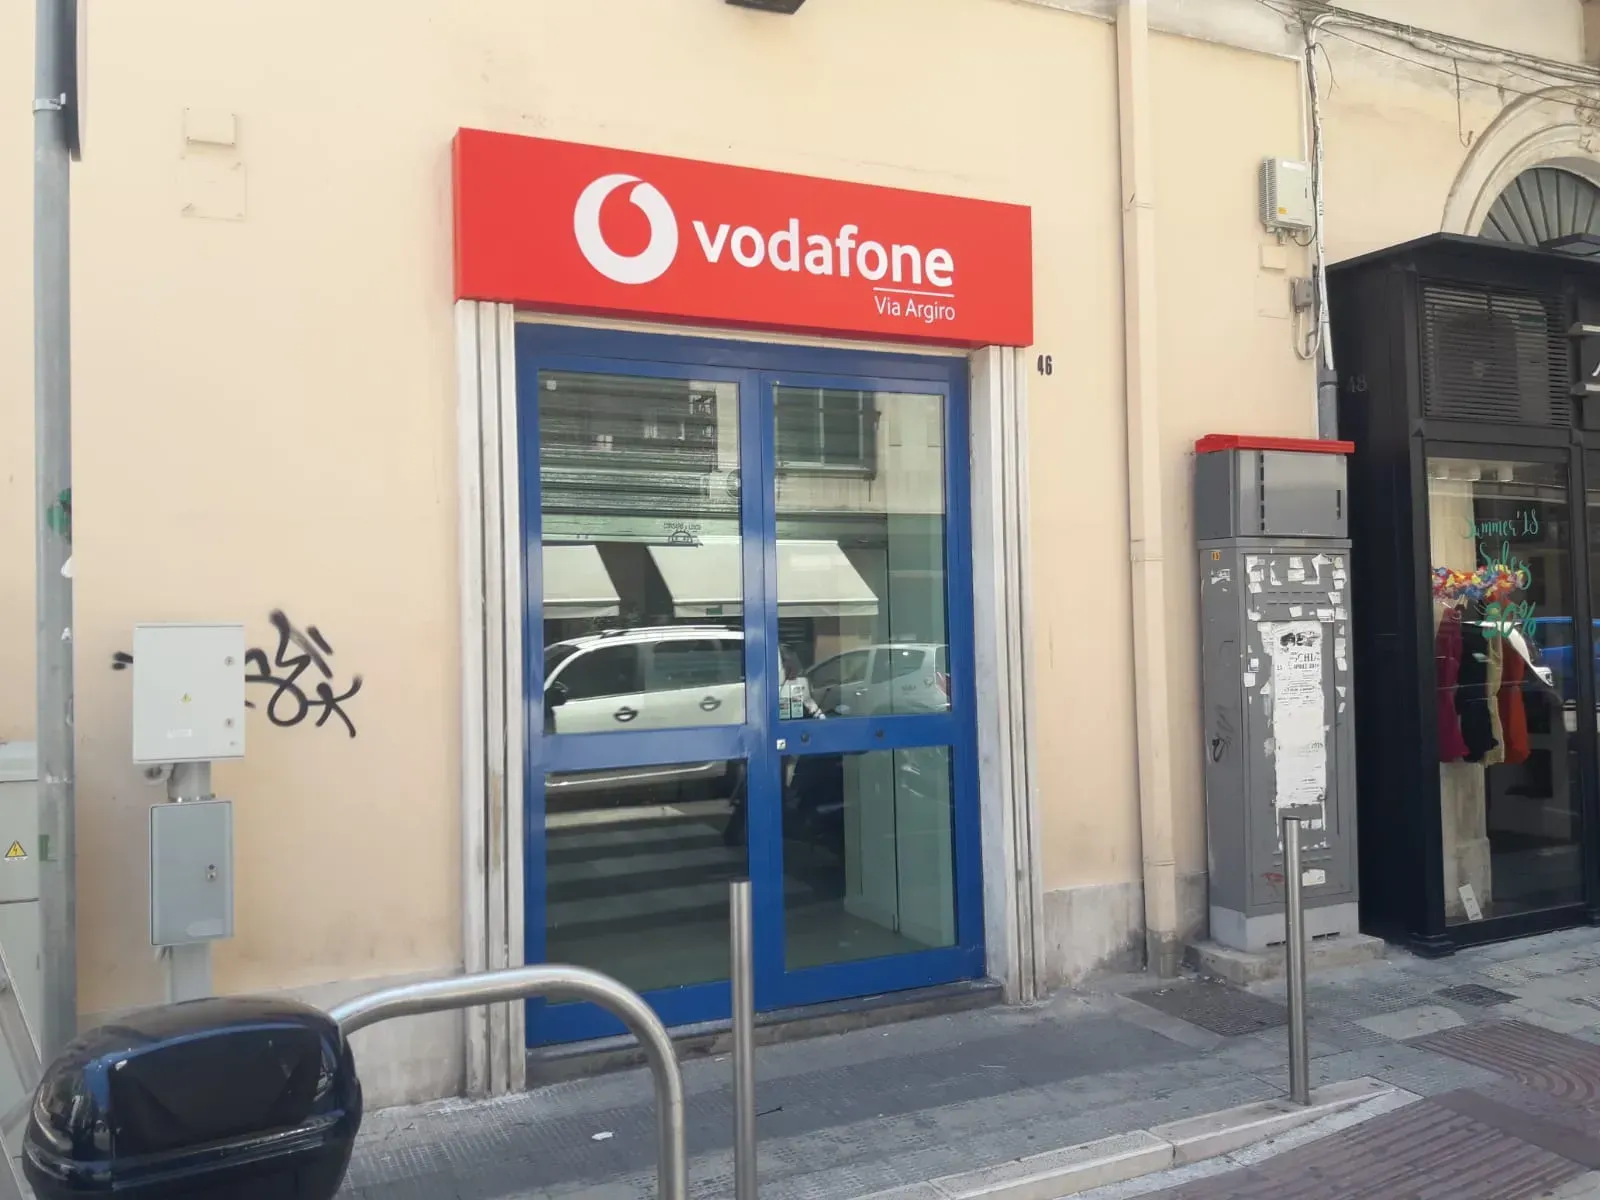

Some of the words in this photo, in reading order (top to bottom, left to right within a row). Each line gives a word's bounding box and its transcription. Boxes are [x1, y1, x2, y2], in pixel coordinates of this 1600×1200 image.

[692, 218, 954, 287] vodafone
[874, 295, 901, 316] Via
[905, 298, 956, 324] Argiro
[1037, 354, 1053, 376] 46
